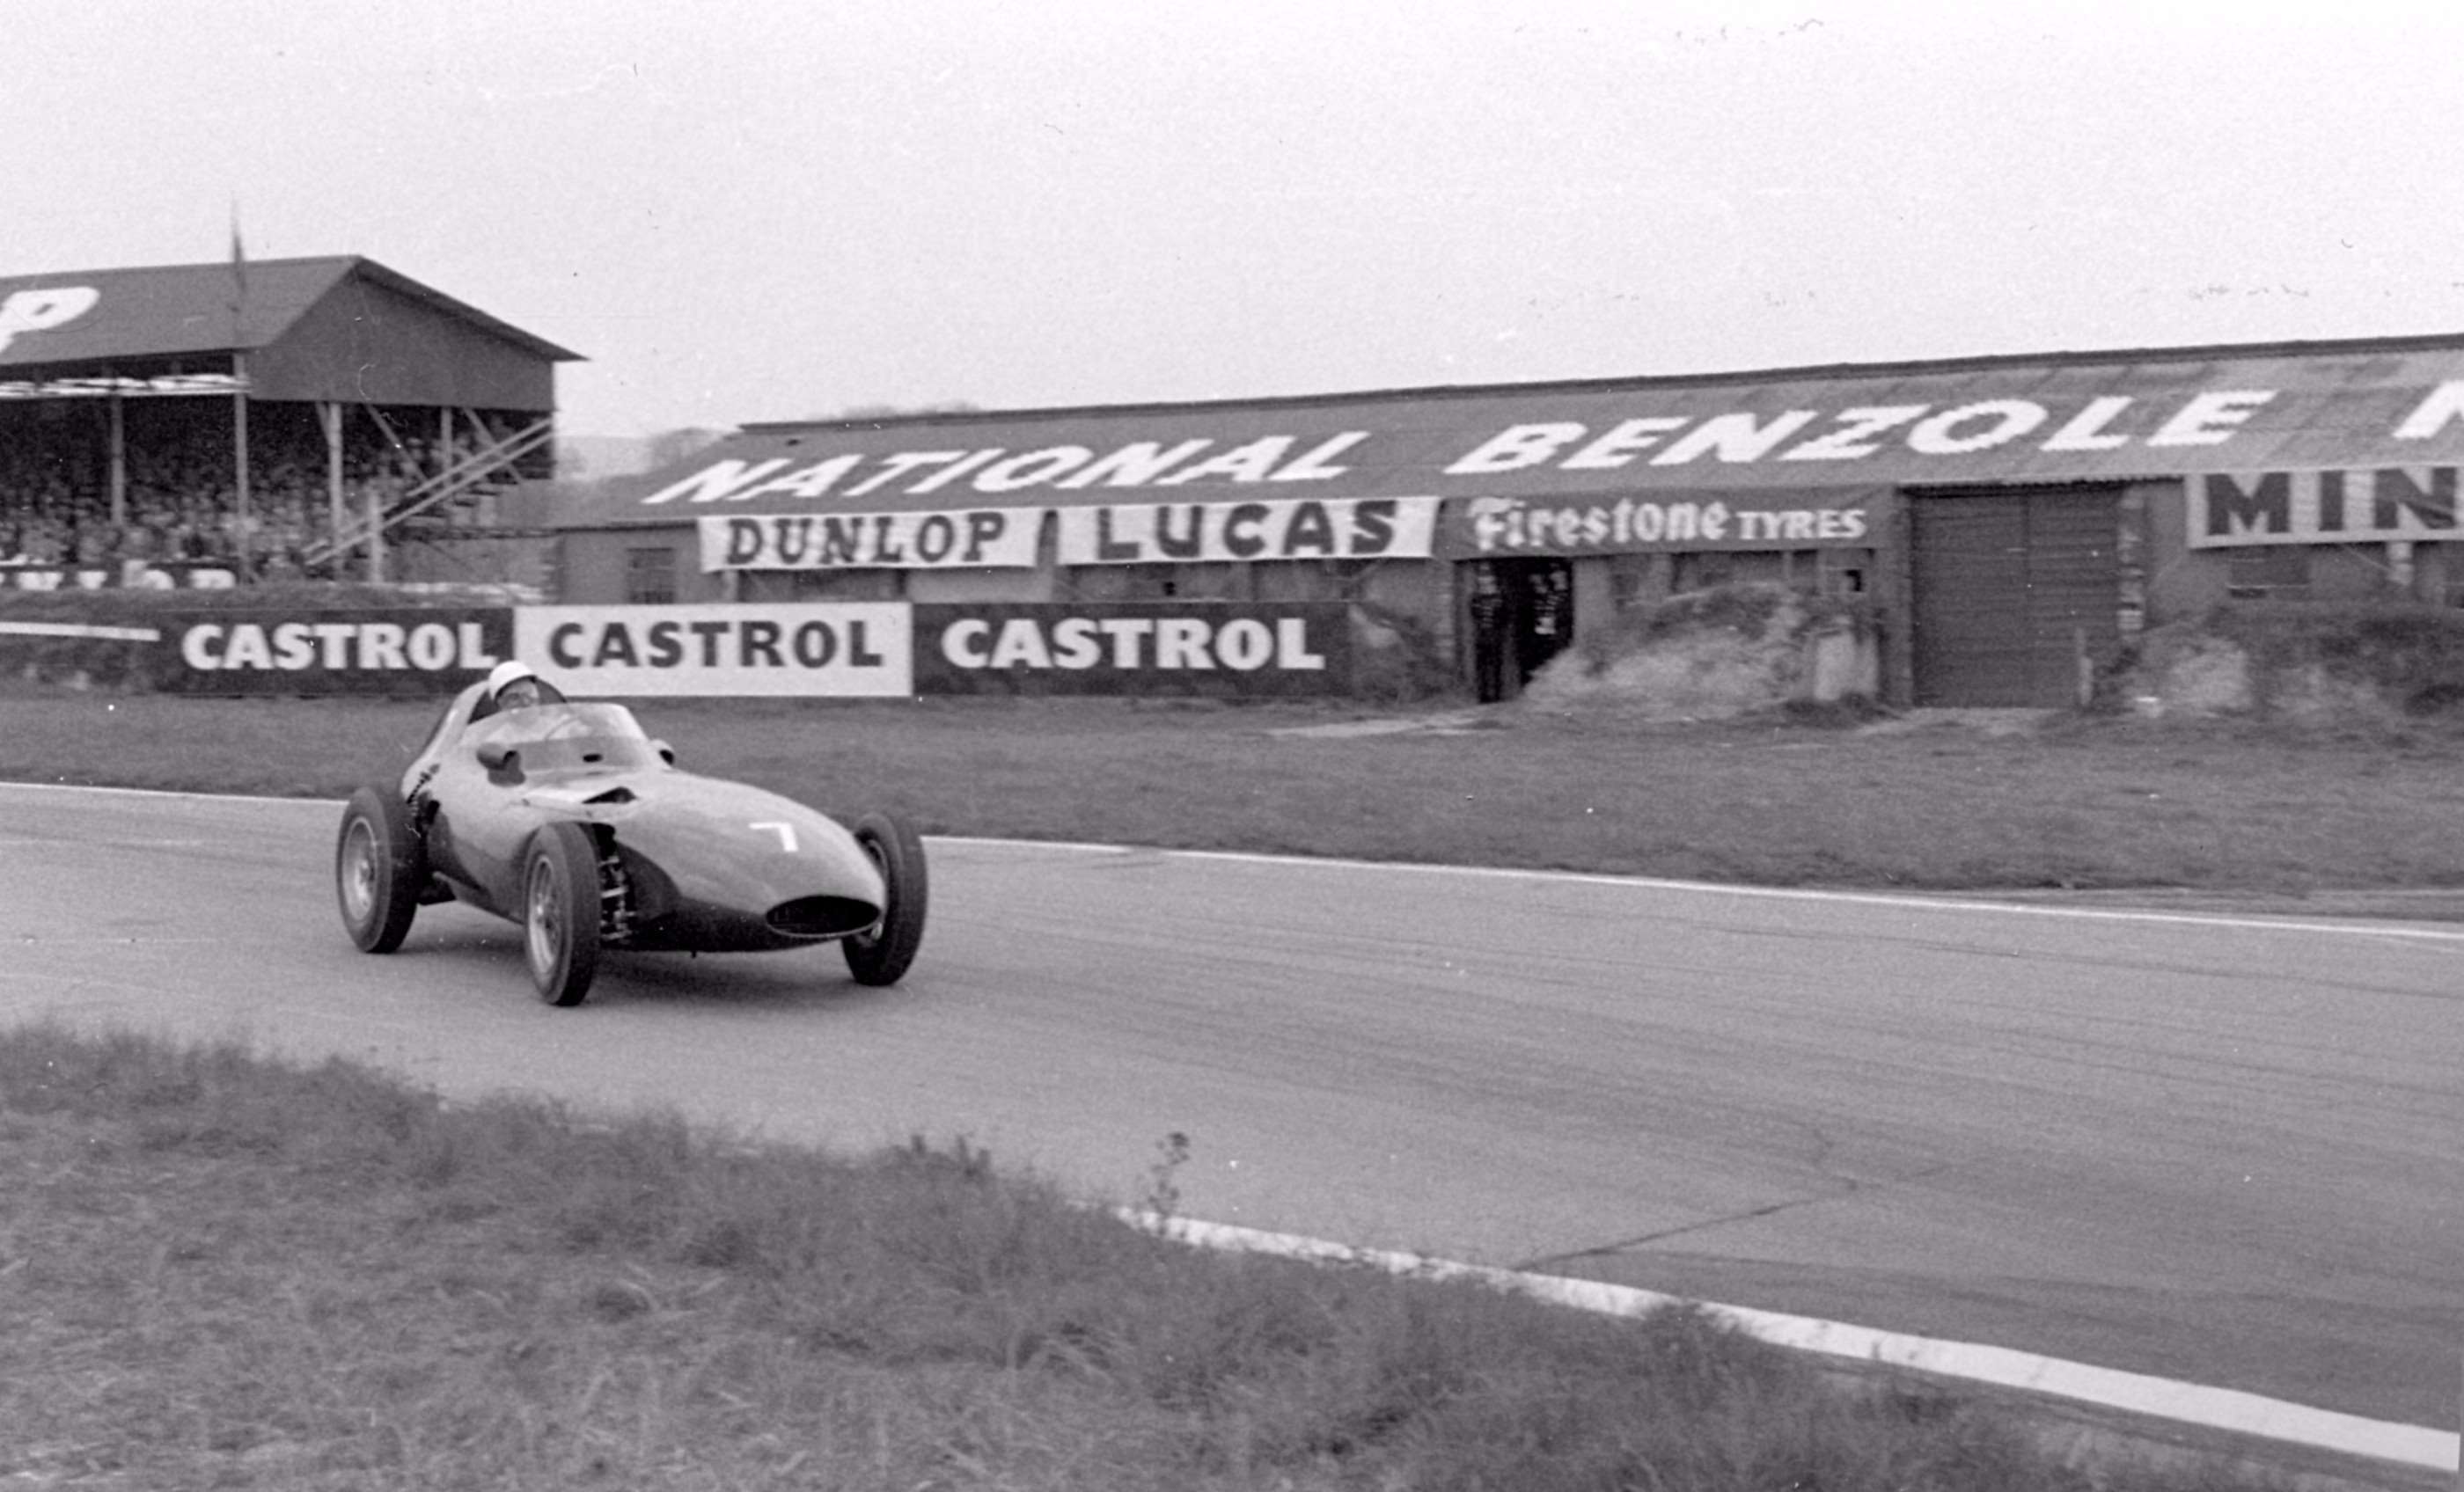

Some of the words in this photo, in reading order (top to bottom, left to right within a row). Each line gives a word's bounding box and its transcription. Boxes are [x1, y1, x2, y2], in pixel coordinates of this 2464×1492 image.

[641, 431, 1371, 504] NATIONAL
[1442, 390, 2279, 474] BENZOLE
[1467, 497, 1729, 551] Firestone
[1735, 509, 1866, 540] TYRES
[2204, 466, 2456, 536] MIN
[727, 511, 1007, 565] DUNLOP
[1096, 500, 1397, 560] LUCAS
[181, 622, 498, 670] CASTROL
[548, 620, 884, 669] CASTROL
[942, 618, 1325, 670] CASTROL
[748, 822, 799, 852] 7
